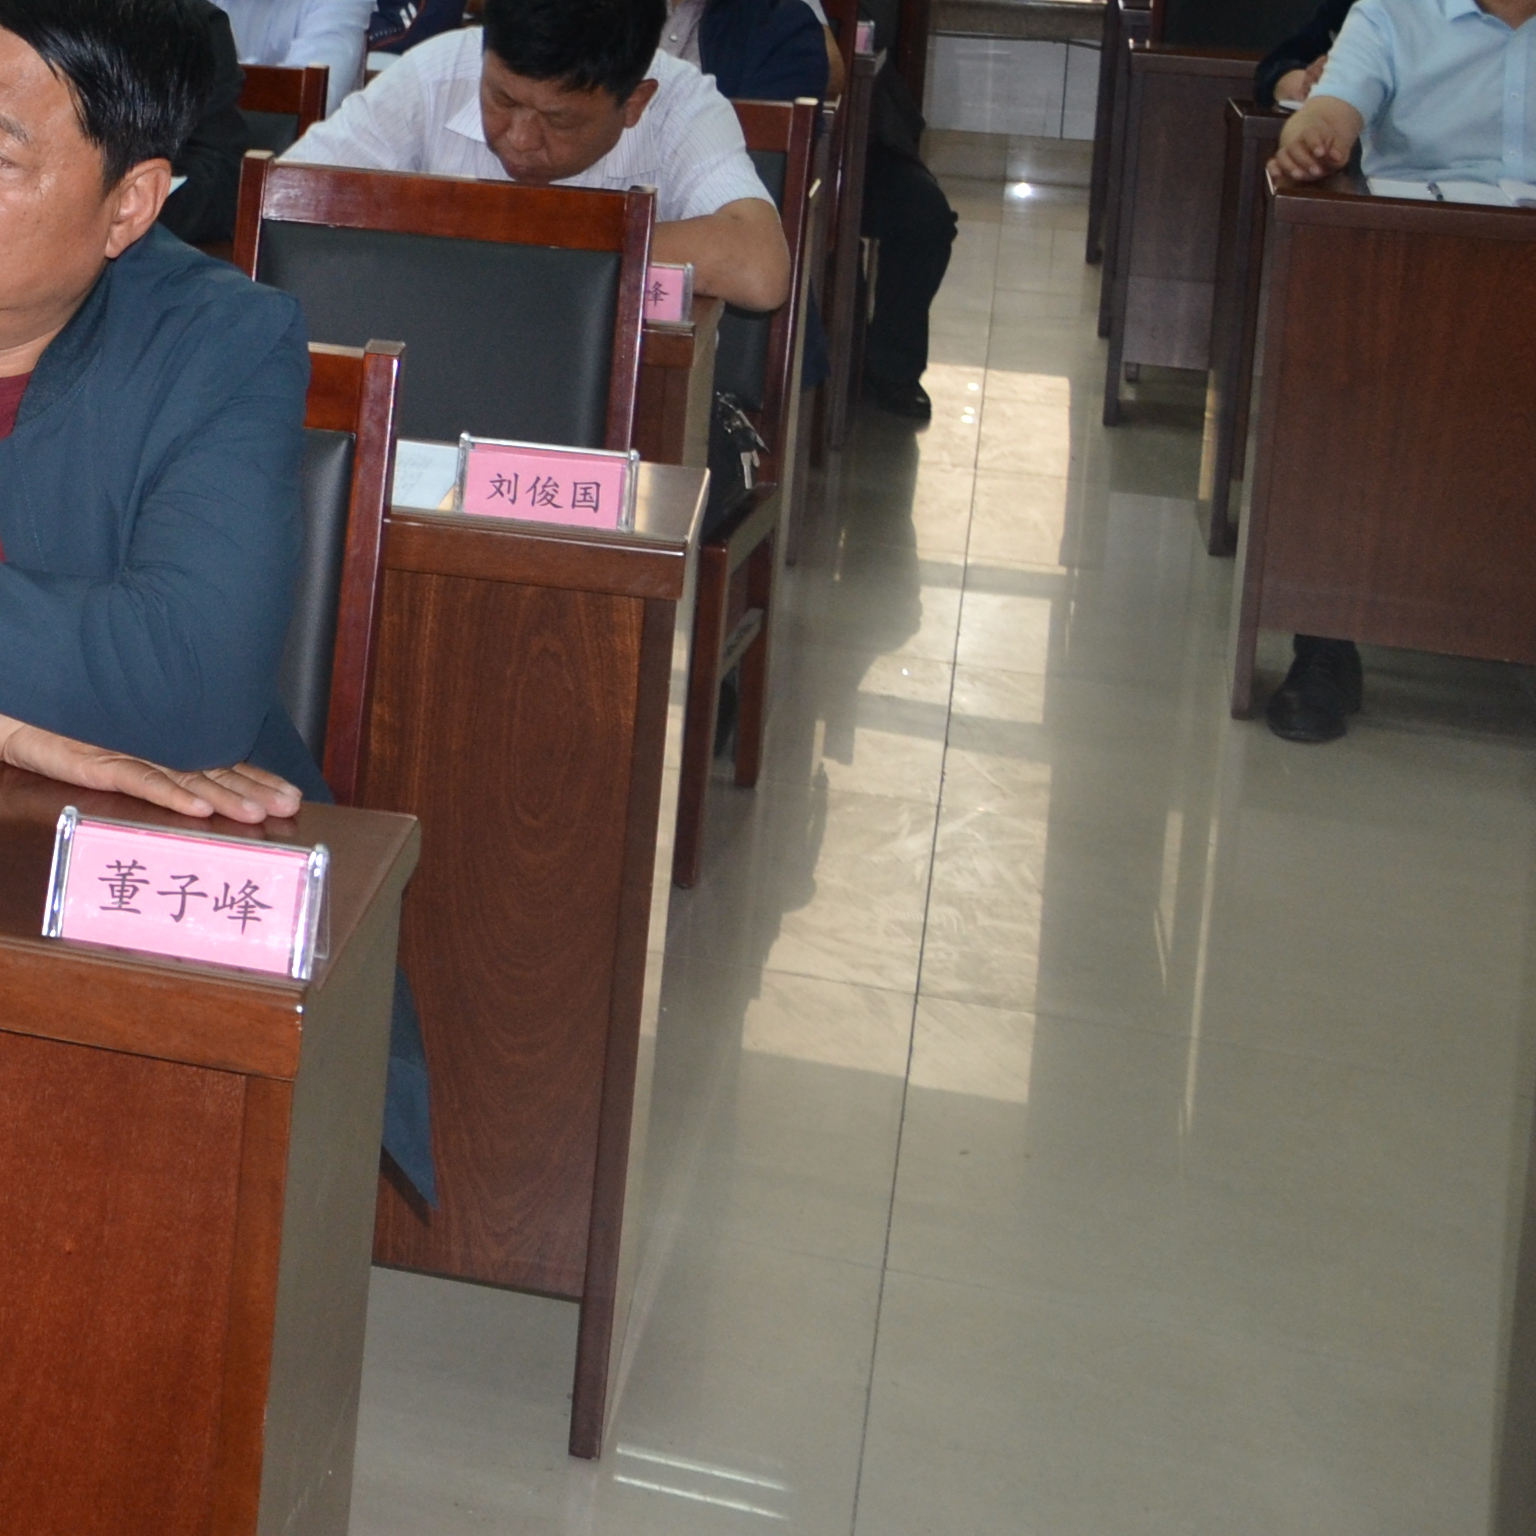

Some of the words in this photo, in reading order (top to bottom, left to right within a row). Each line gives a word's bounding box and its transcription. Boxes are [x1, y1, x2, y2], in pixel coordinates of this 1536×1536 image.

[487, 472, 601, 513] 刘俊国
[97, 859, 273, 935] 董子峰
